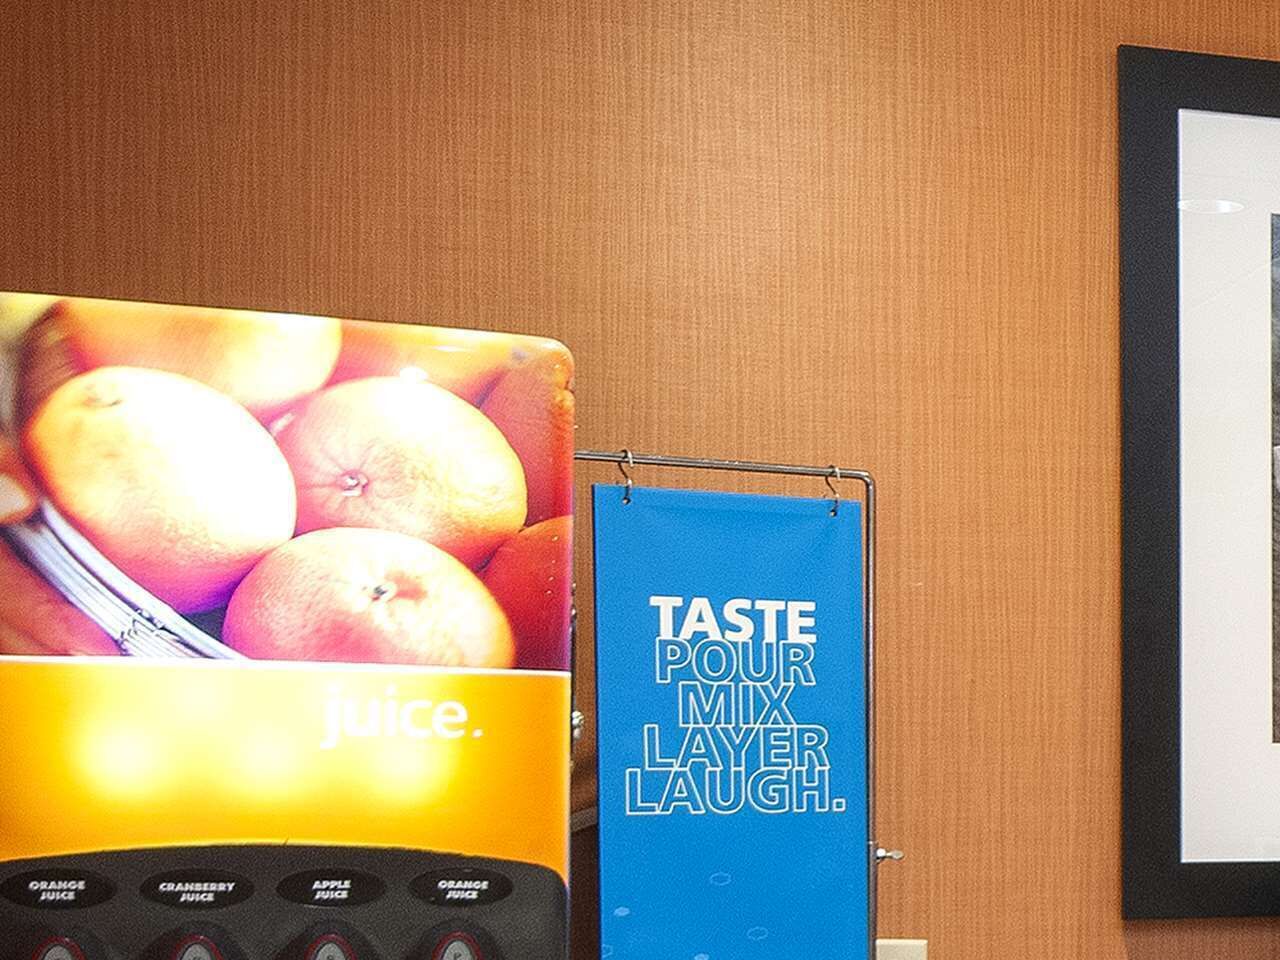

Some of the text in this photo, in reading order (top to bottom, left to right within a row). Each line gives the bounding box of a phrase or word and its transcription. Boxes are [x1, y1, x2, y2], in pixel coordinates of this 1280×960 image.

[649, 595, 817, 643] TASTE
[655, 636, 817, 686] POUR
[678, 681, 795, 728] MIX
[319, 683, 484, 750] juice.
[643, 724, 830, 771] LAYER
[625, 768, 846, 816] LAUGH.
[28, 880, 86, 891] ORANGE
[158, 882, 236, 892] CRANBERRY
[312, 880, 351, 890] APPLE
[437, 880, 489, 890] ORANGE
[40, 890, 76, 901] JUICE
[180, 891, 215, 902] JUICE
[314, 889, 349, 900] JUICE
[445, 889, 479, 900] JUICE
